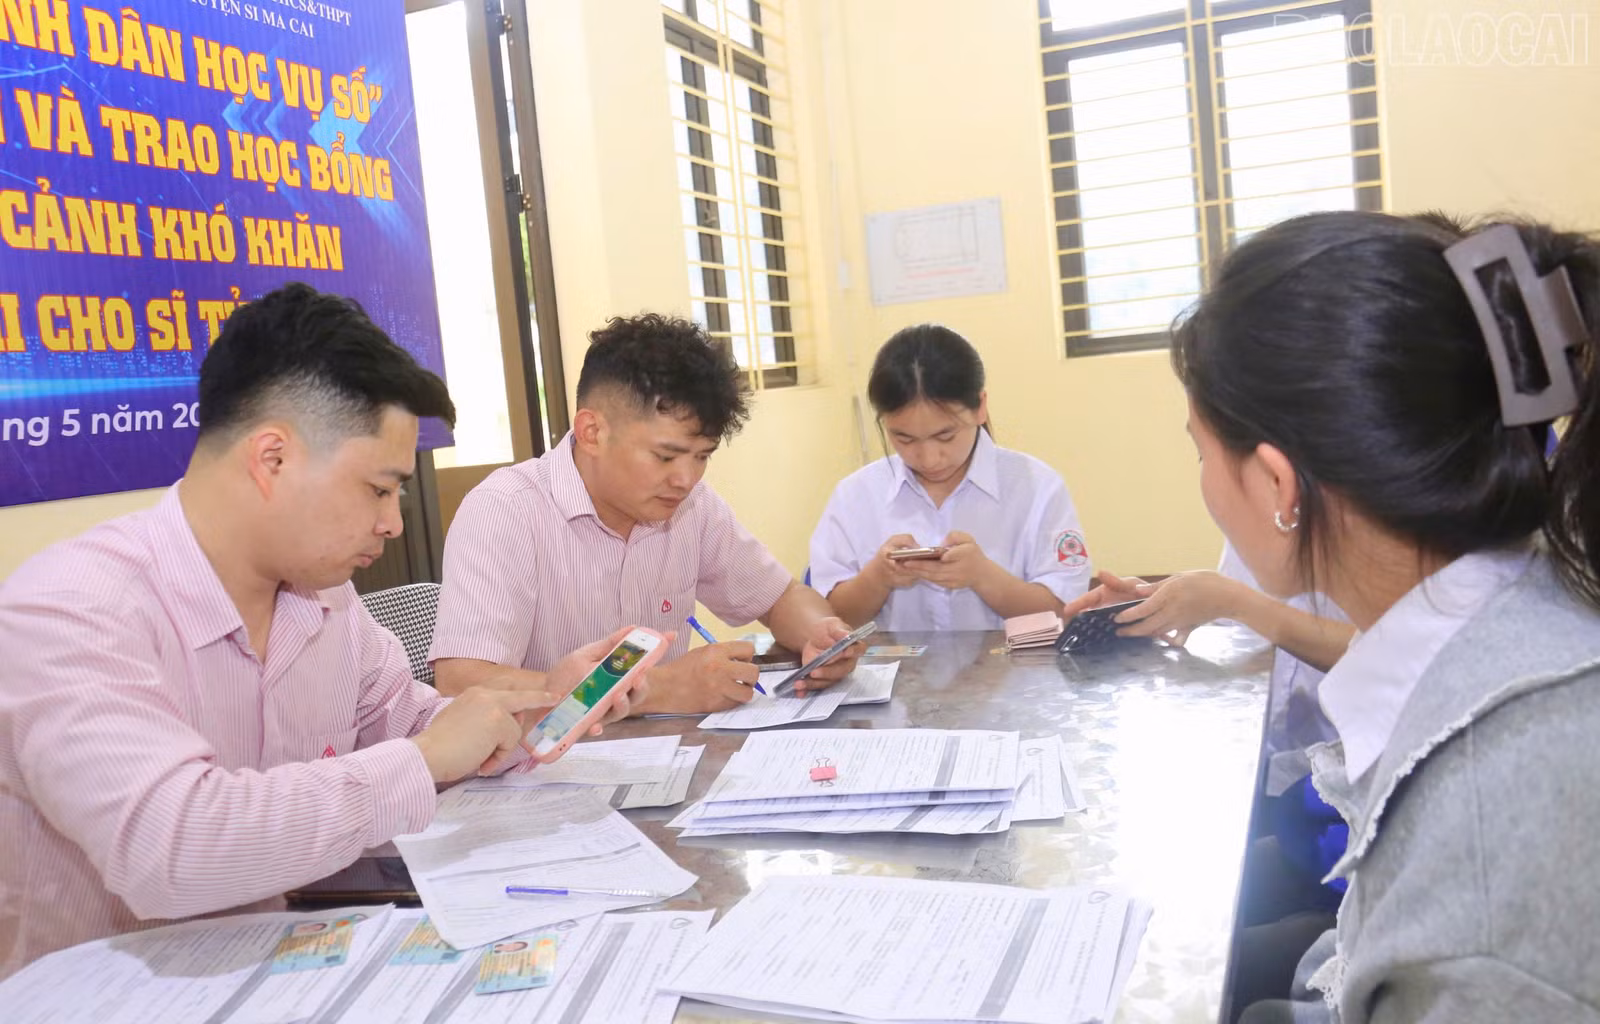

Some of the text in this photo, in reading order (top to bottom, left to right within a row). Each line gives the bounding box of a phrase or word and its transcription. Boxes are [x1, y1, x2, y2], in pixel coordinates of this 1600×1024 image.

[244, 4, 259, 21] SI
[262, 9, 286, 29] MA
[289, 18, 314, 38] CAI
[83, 7, 186, 82] DÂN
[193, 36, 271, 104] HỌC
[277, 58, 324, 120] VỤ
[15, 86, 93, 157] VÀ
[100, 105, 219, 175] TRAO
[228, 131, 301, 191] HỌC
[307, 132, 394, 200] BỔNG
[0, 177, 344, 271] CẢNH KHÓ KHĂN
[37, 294, 135, 352] CHO
[146, 289, 191, 351] SĨ
[61, 409, 80, 436] 5
[91, 404, 163, 434] năm
